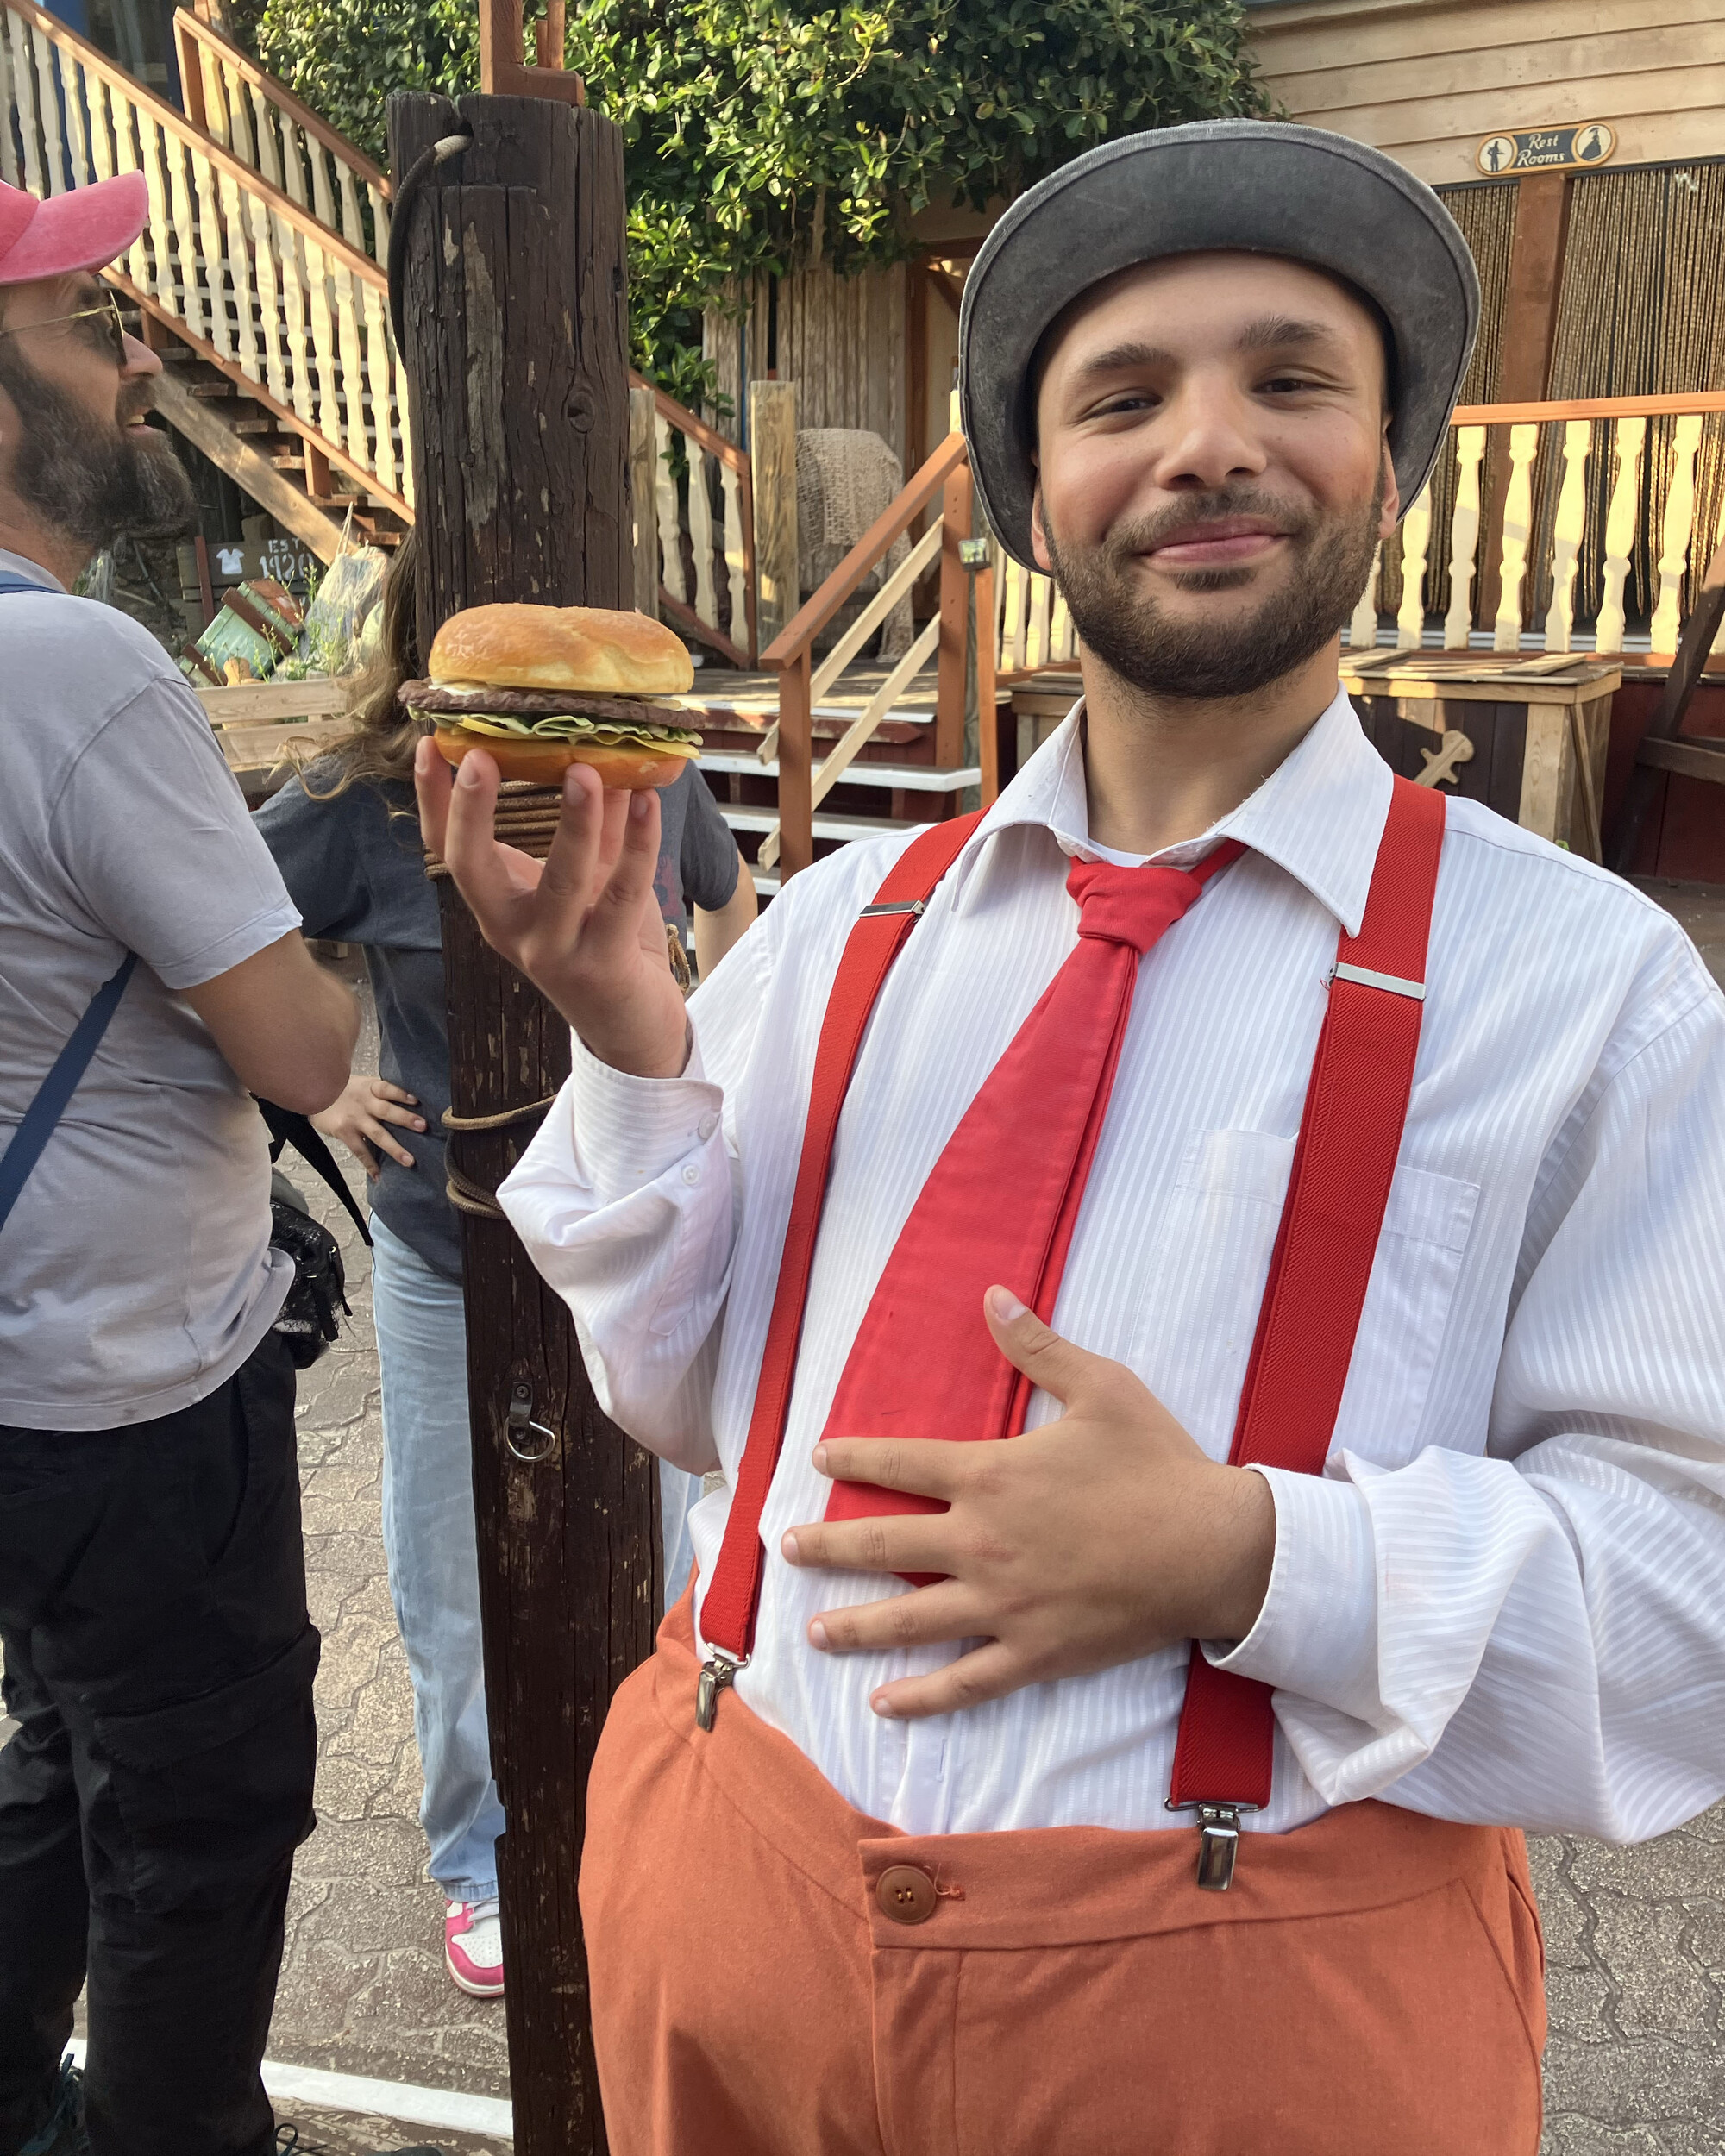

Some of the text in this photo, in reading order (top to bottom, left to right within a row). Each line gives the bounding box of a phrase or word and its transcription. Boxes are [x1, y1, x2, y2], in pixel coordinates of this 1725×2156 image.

[1528, 133, 1559, 150] Rest
[1517, 149, 1565, 167] Rooms
[259, 552, 315, 581] 1920
